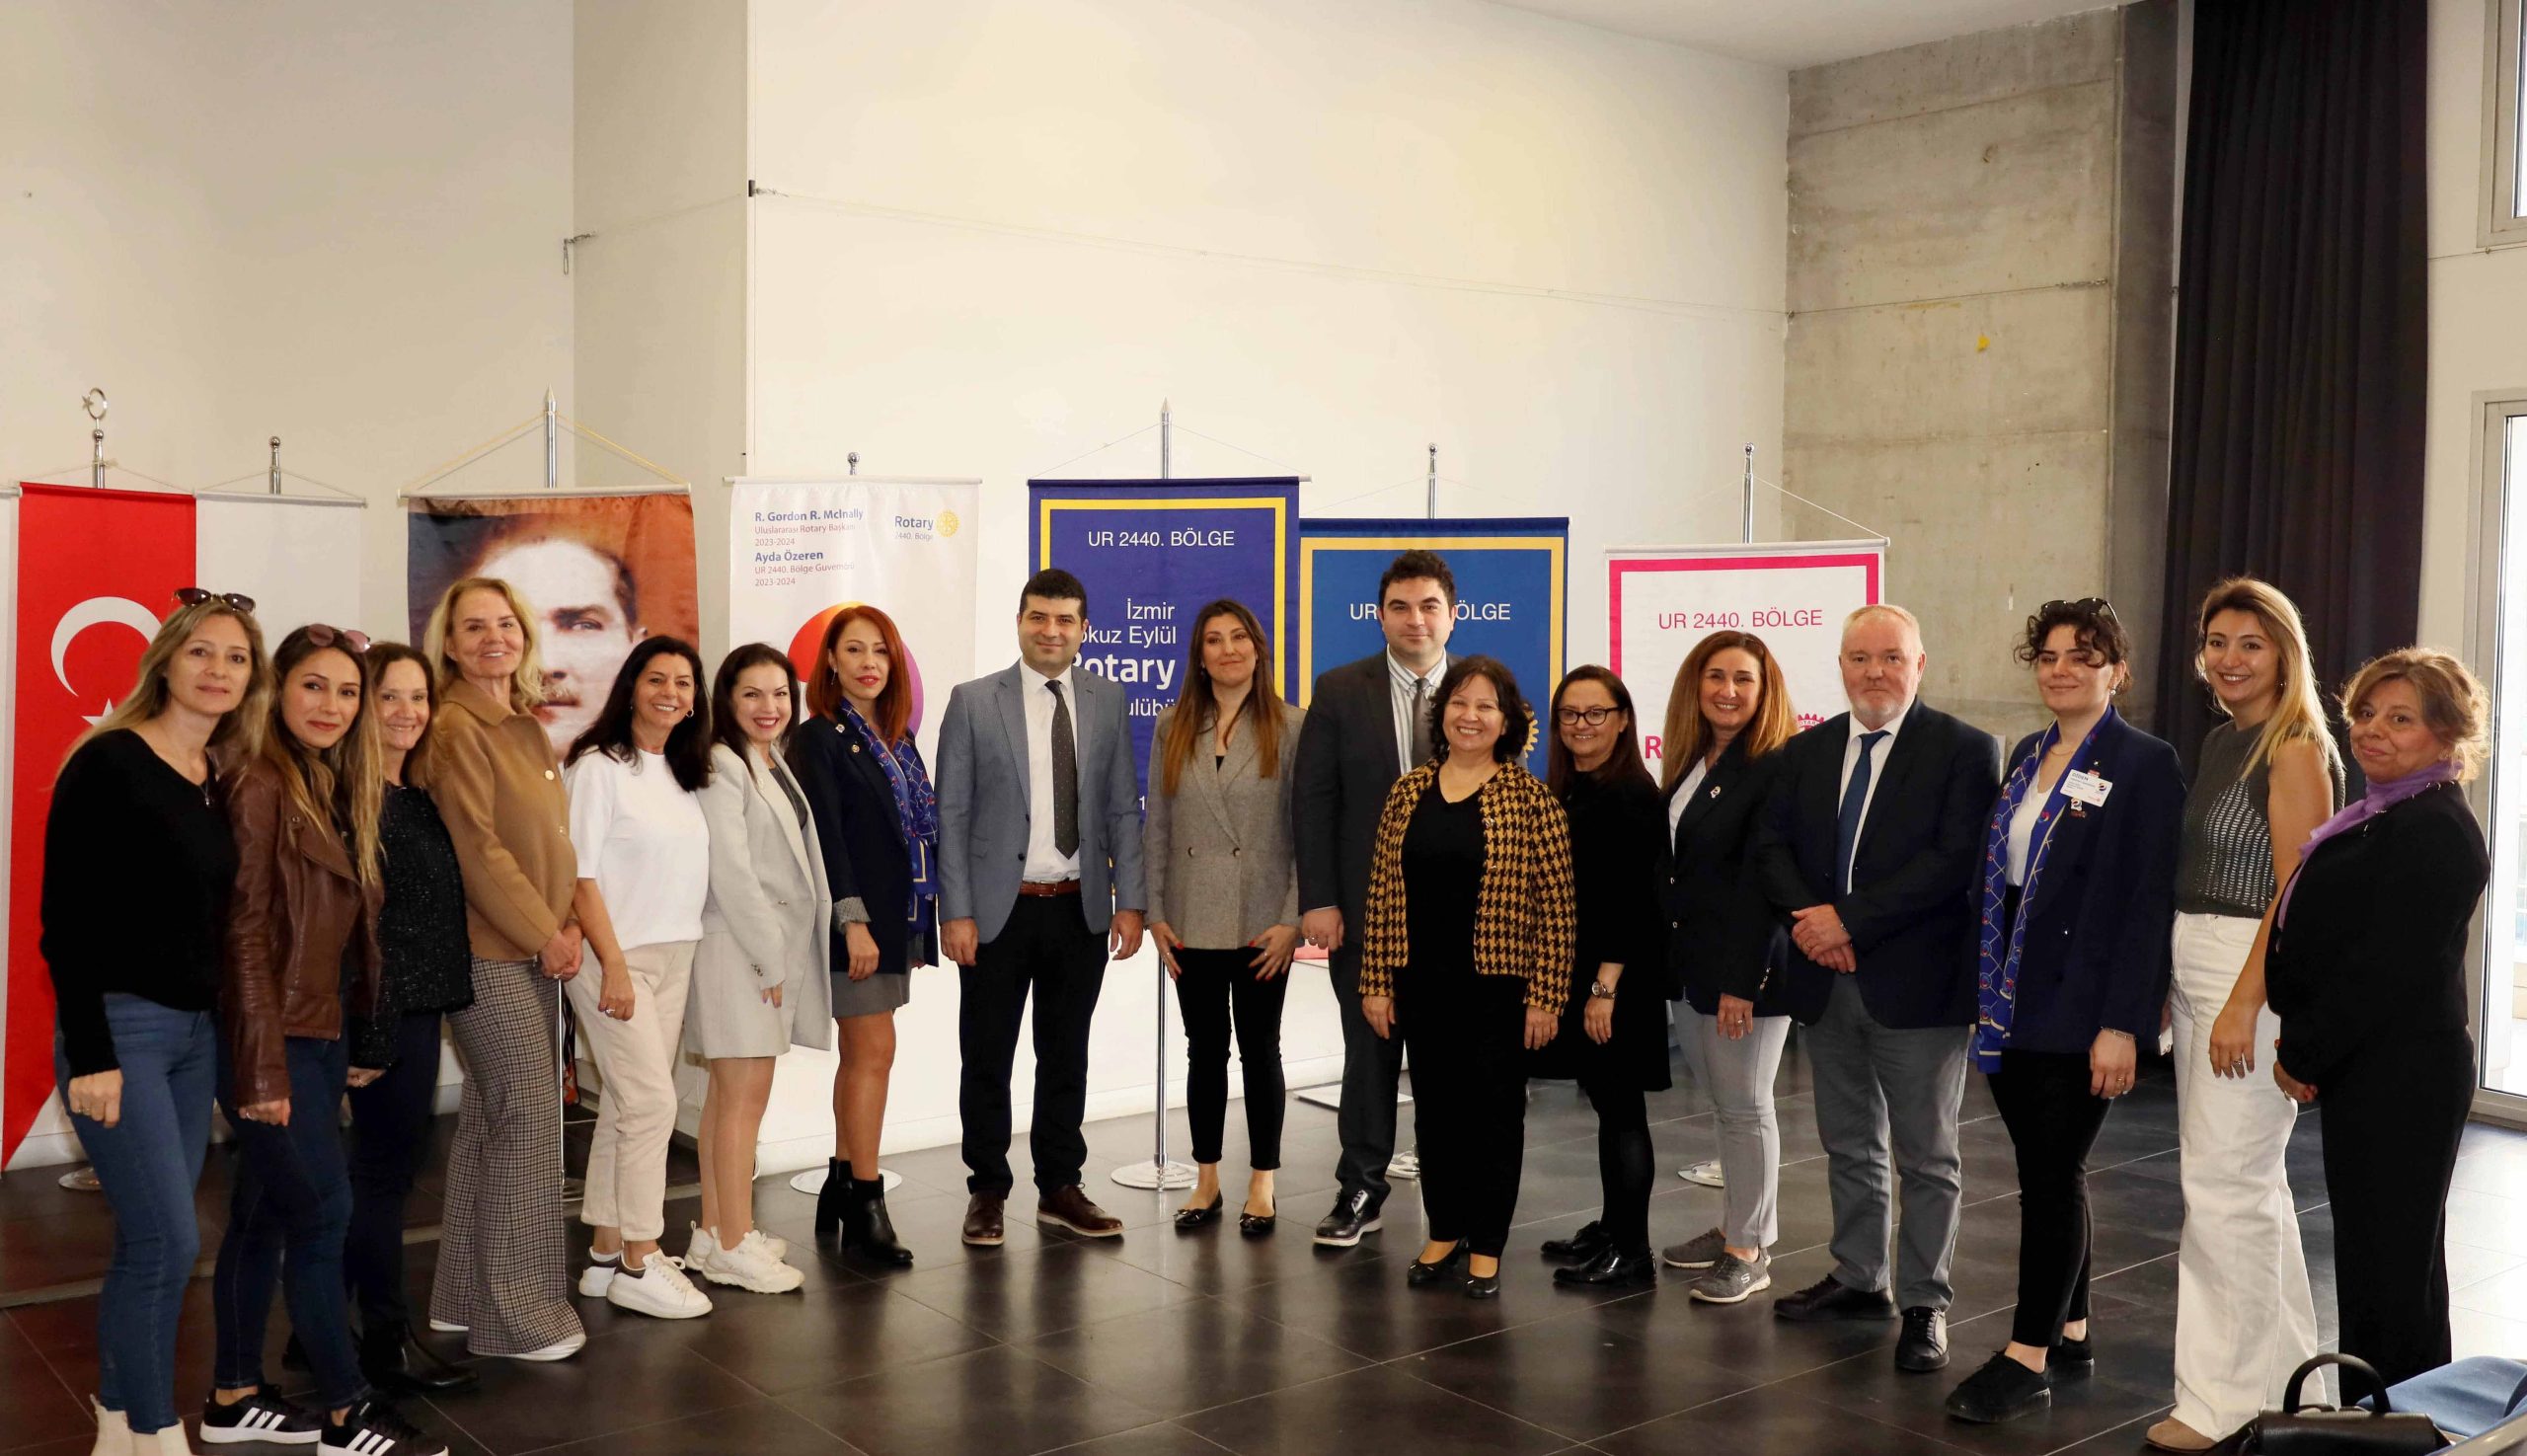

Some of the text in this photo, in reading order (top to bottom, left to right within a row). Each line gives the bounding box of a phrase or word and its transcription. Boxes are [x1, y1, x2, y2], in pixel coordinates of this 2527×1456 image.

[755, 507, 864, 522] R. Gordon R. McInally
[894, 515, 934, 531] Rotary
[800, 523, 827, 534] Rotary
[1088, 527, 1235, 547] UR 2440. BÖLGE
[755, 549, 824, 565] Ayda Özeren
[754, 566, 766, 575] UR
[1127, 597, 1176, 620] İzmir
[1349, 599, 1511, 621] UR ÖLGE
[1658, 606, 1823, 630] UR 2440. BÖLGE
[1129, 625, 1177, 649] Eylül
